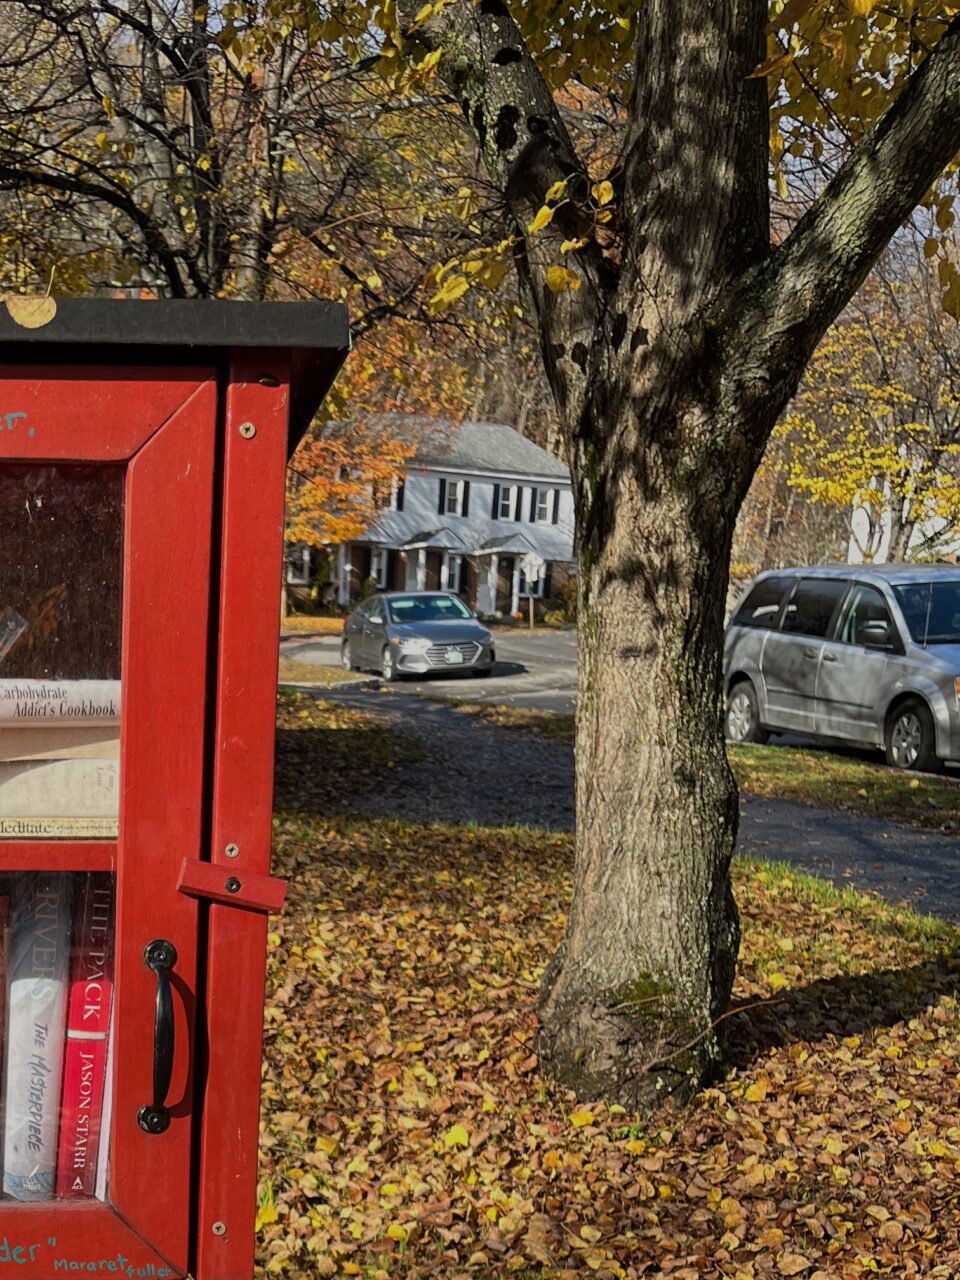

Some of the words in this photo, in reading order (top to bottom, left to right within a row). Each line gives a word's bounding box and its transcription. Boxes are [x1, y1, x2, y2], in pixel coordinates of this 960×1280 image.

[12, 700, 56, 719] Addict's
[58, 700, 117, 717] Cookbook
[89, 887, 113, 942] THE
[30, 889, 60, 1001] RIVERS
[82, 949, 105, 1023] PACK
[33, 1022, 49, 1049] THE
[26, 1053, 52, 1153] MASTERPIECE
[78, 1051, 96, 1111] JASON
[72, 1113, 90, 1170] STARR
